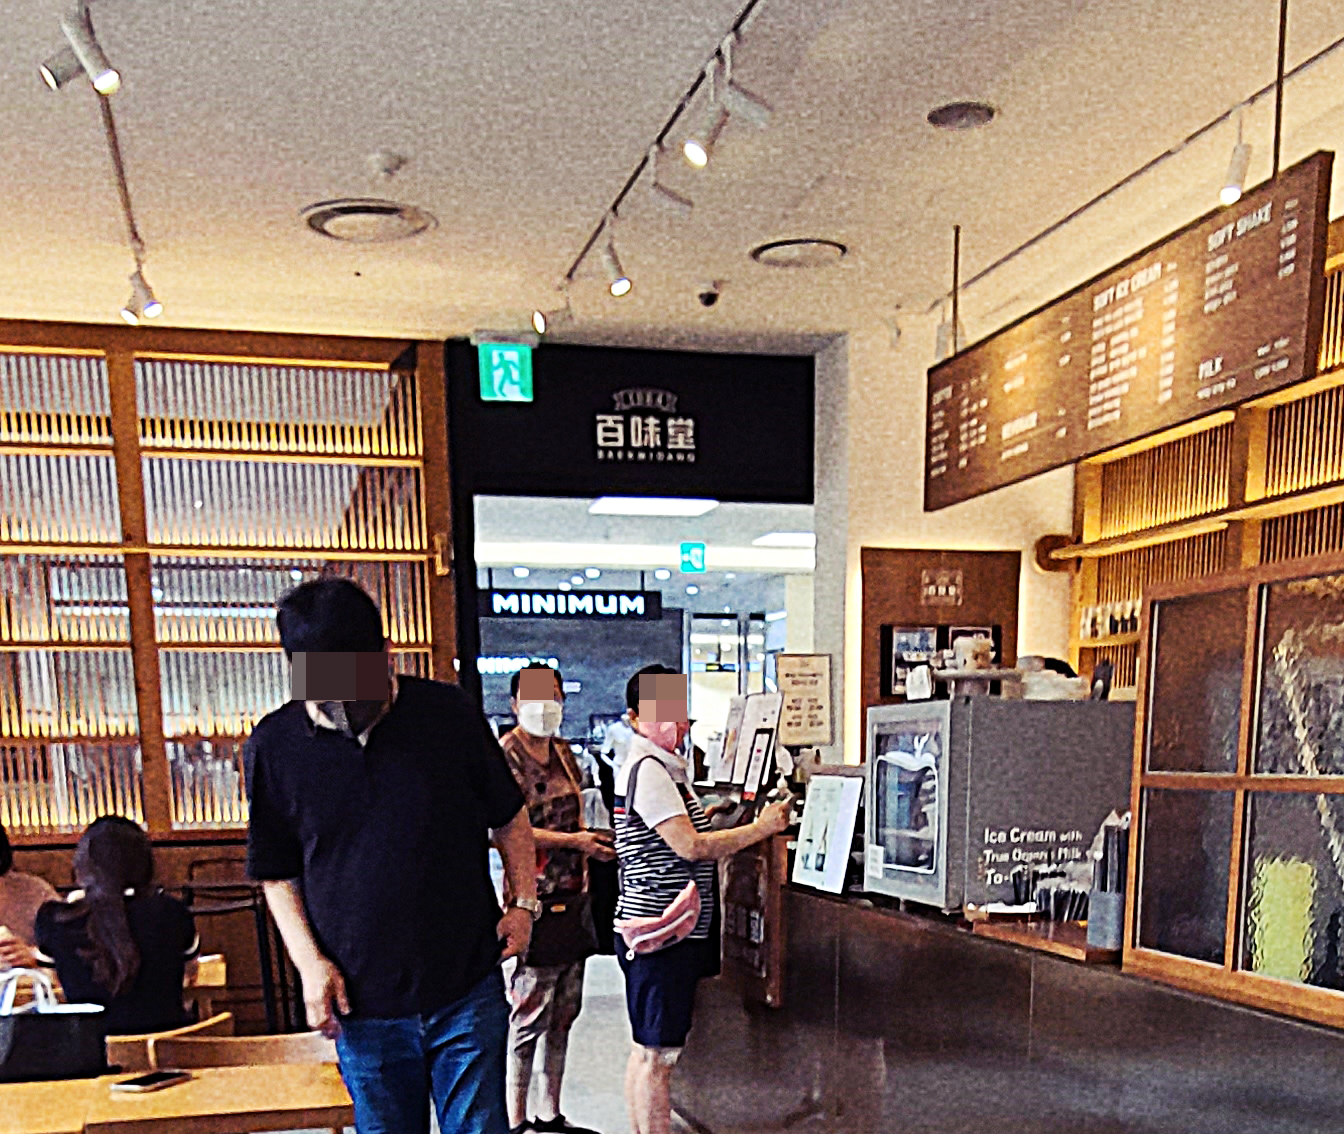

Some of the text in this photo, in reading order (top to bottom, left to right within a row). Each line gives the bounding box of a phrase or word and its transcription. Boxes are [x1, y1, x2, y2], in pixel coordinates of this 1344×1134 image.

[596, 413, 696, 450] 百味堂
[492, 592, 645, 615] MINIMUM
[984, 826, 1007, 844] Ice
[1009, 826, 1057, 844] Cream
